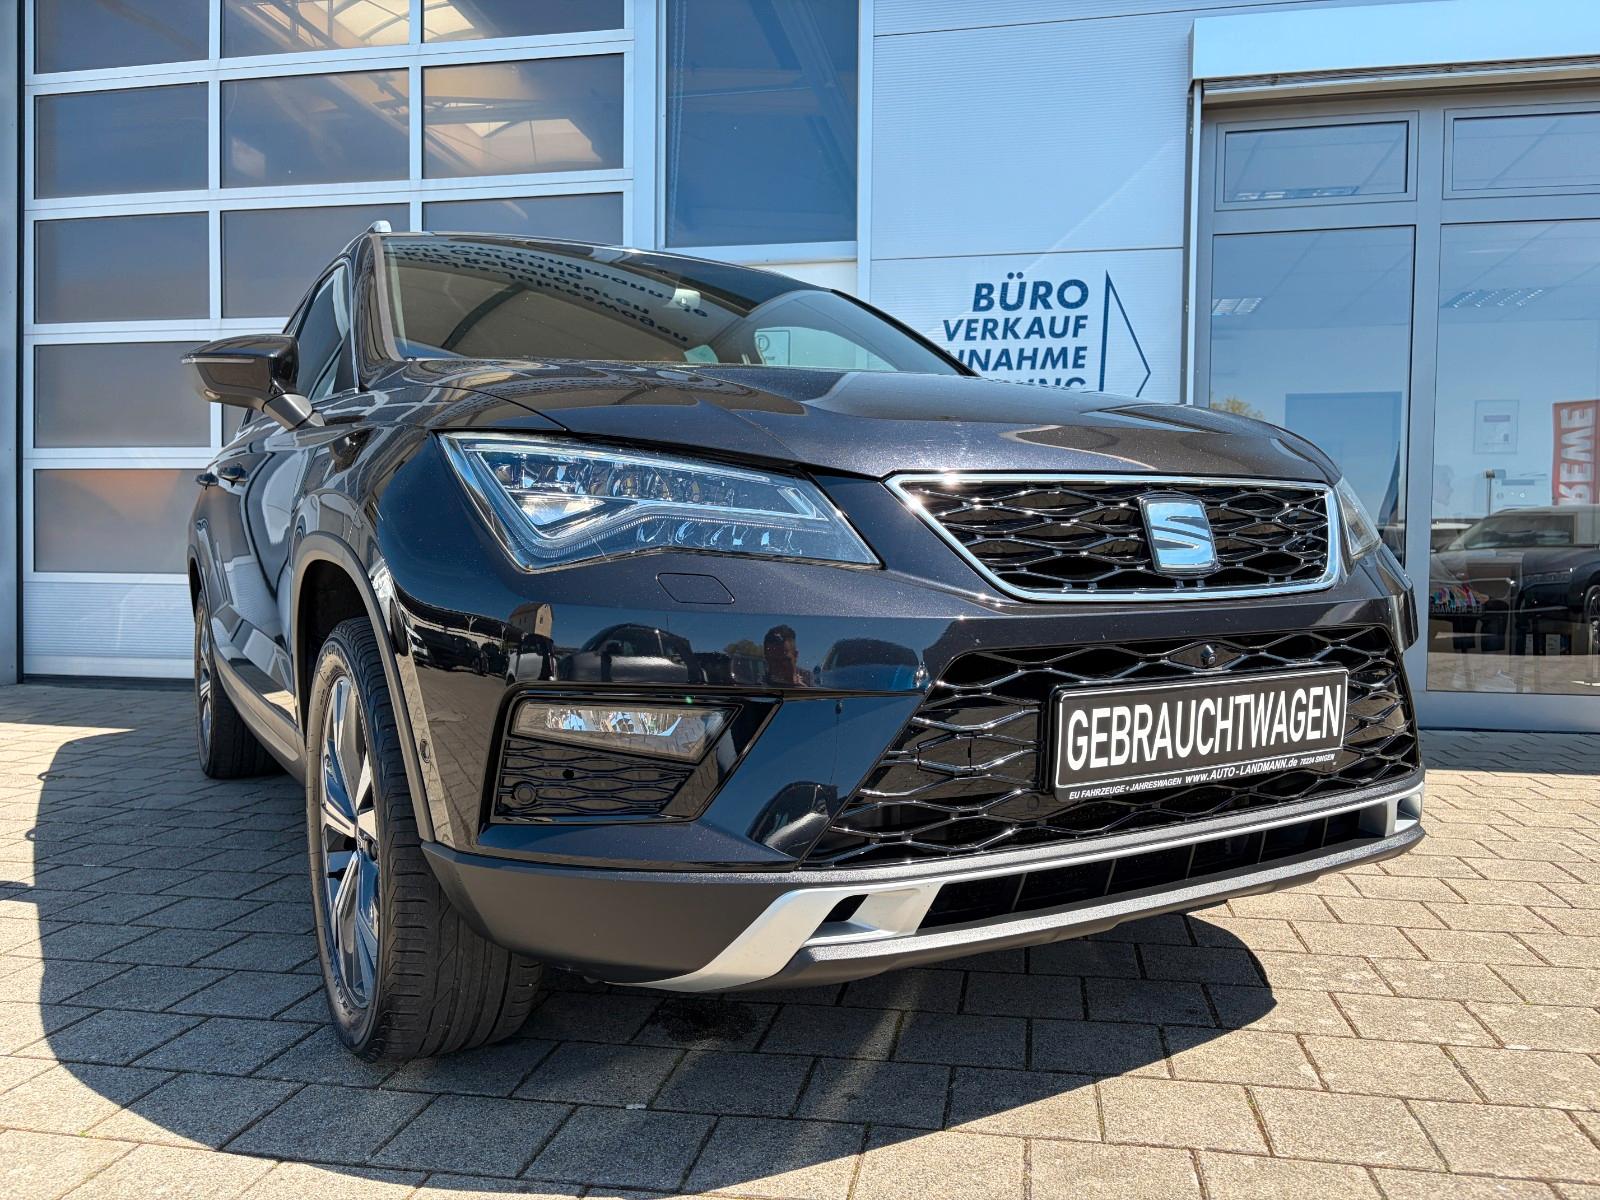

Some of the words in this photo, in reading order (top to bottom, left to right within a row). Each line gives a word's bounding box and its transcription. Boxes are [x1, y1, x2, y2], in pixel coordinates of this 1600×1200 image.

[972, 271, 1089, 312] BÜRO
[943, 315, 1088, 342] VERKAUF
[1067, 684, 1342, 770] GEBRAUCHTWAGEN
[1069, 791, 1080, 800] EU
